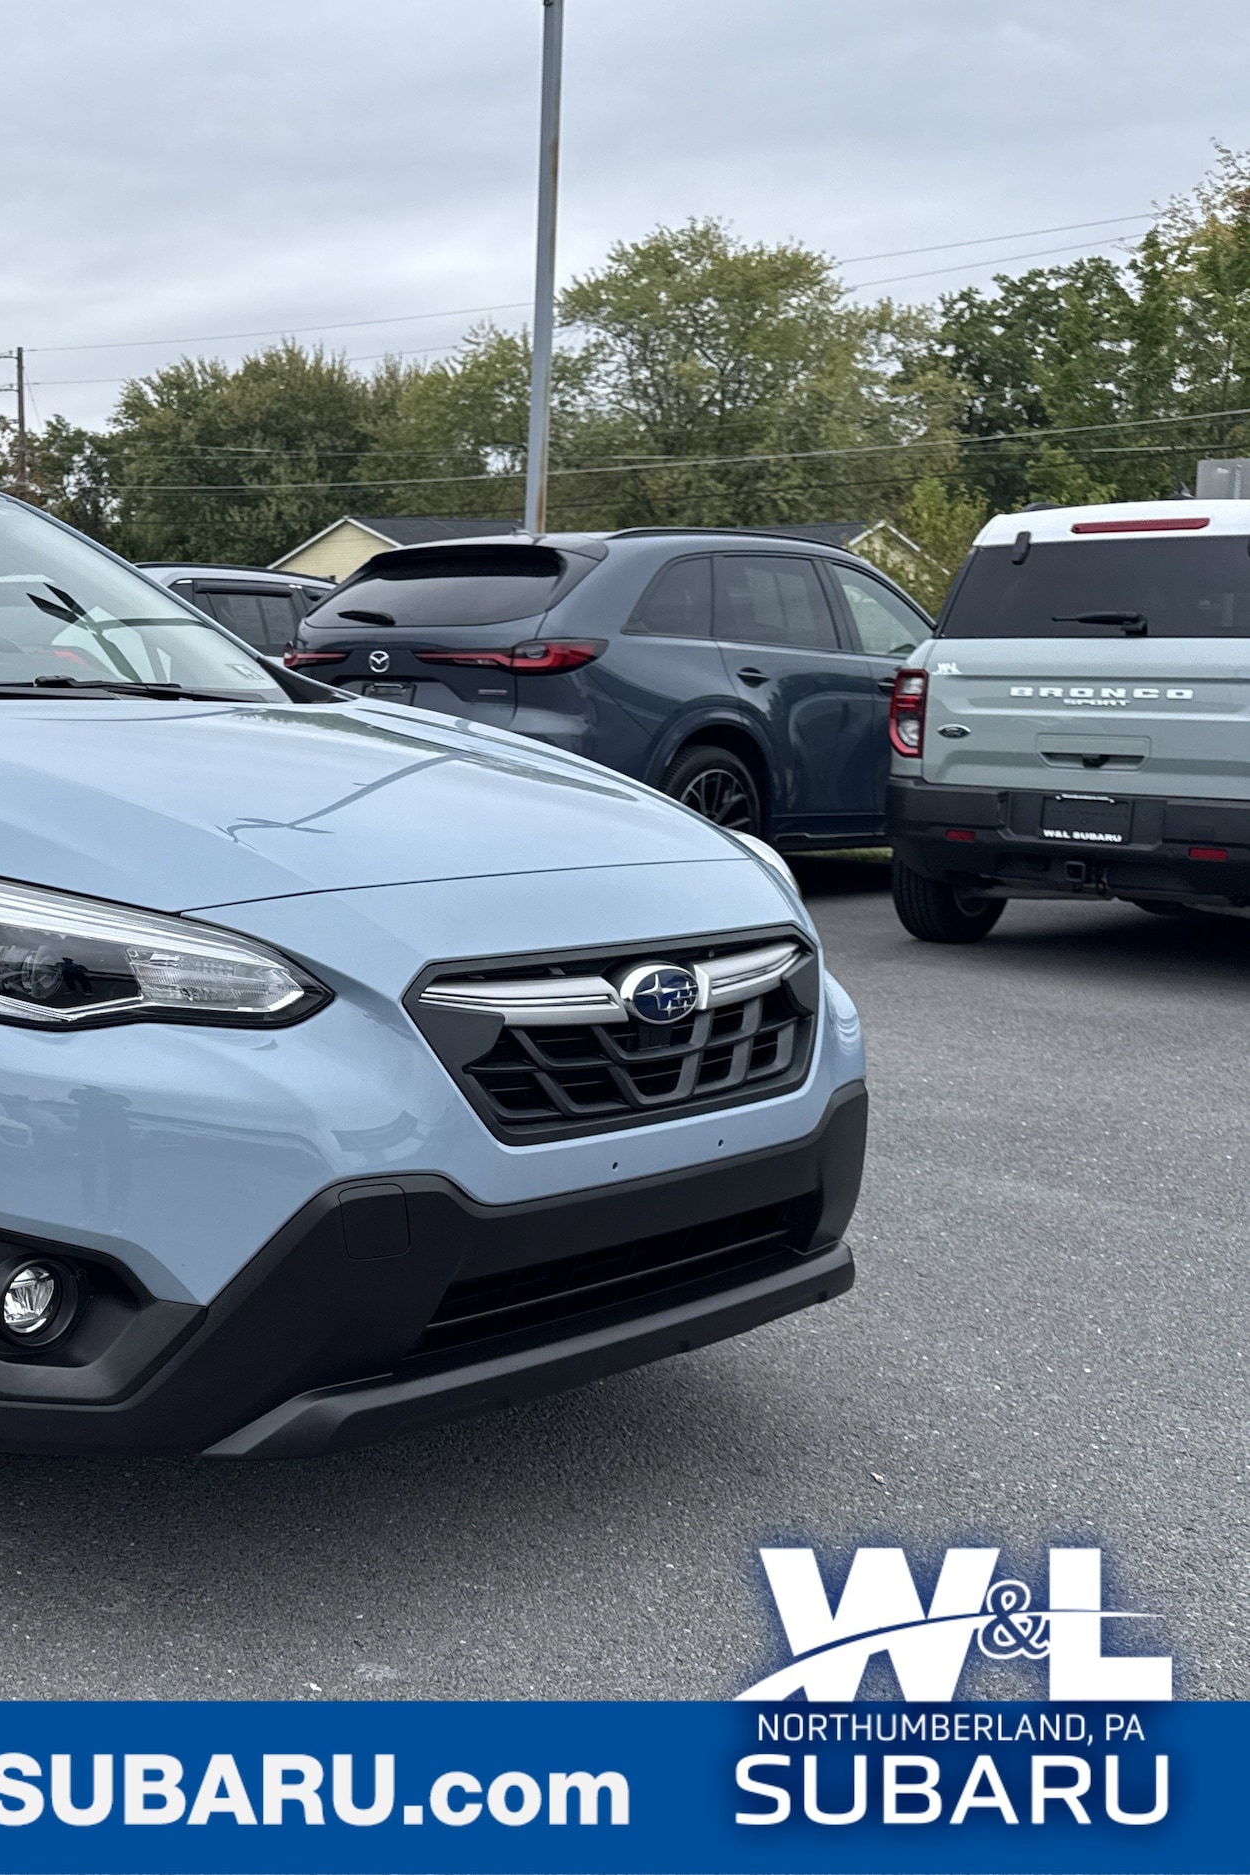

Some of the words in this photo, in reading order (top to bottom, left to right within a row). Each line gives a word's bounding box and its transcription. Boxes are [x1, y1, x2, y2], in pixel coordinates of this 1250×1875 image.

[1009, 685, 1195, 700] BRONCO
[1062, 698, 1132, 707] SPORT
[1072, 829, 1124, 843] SUBARU
